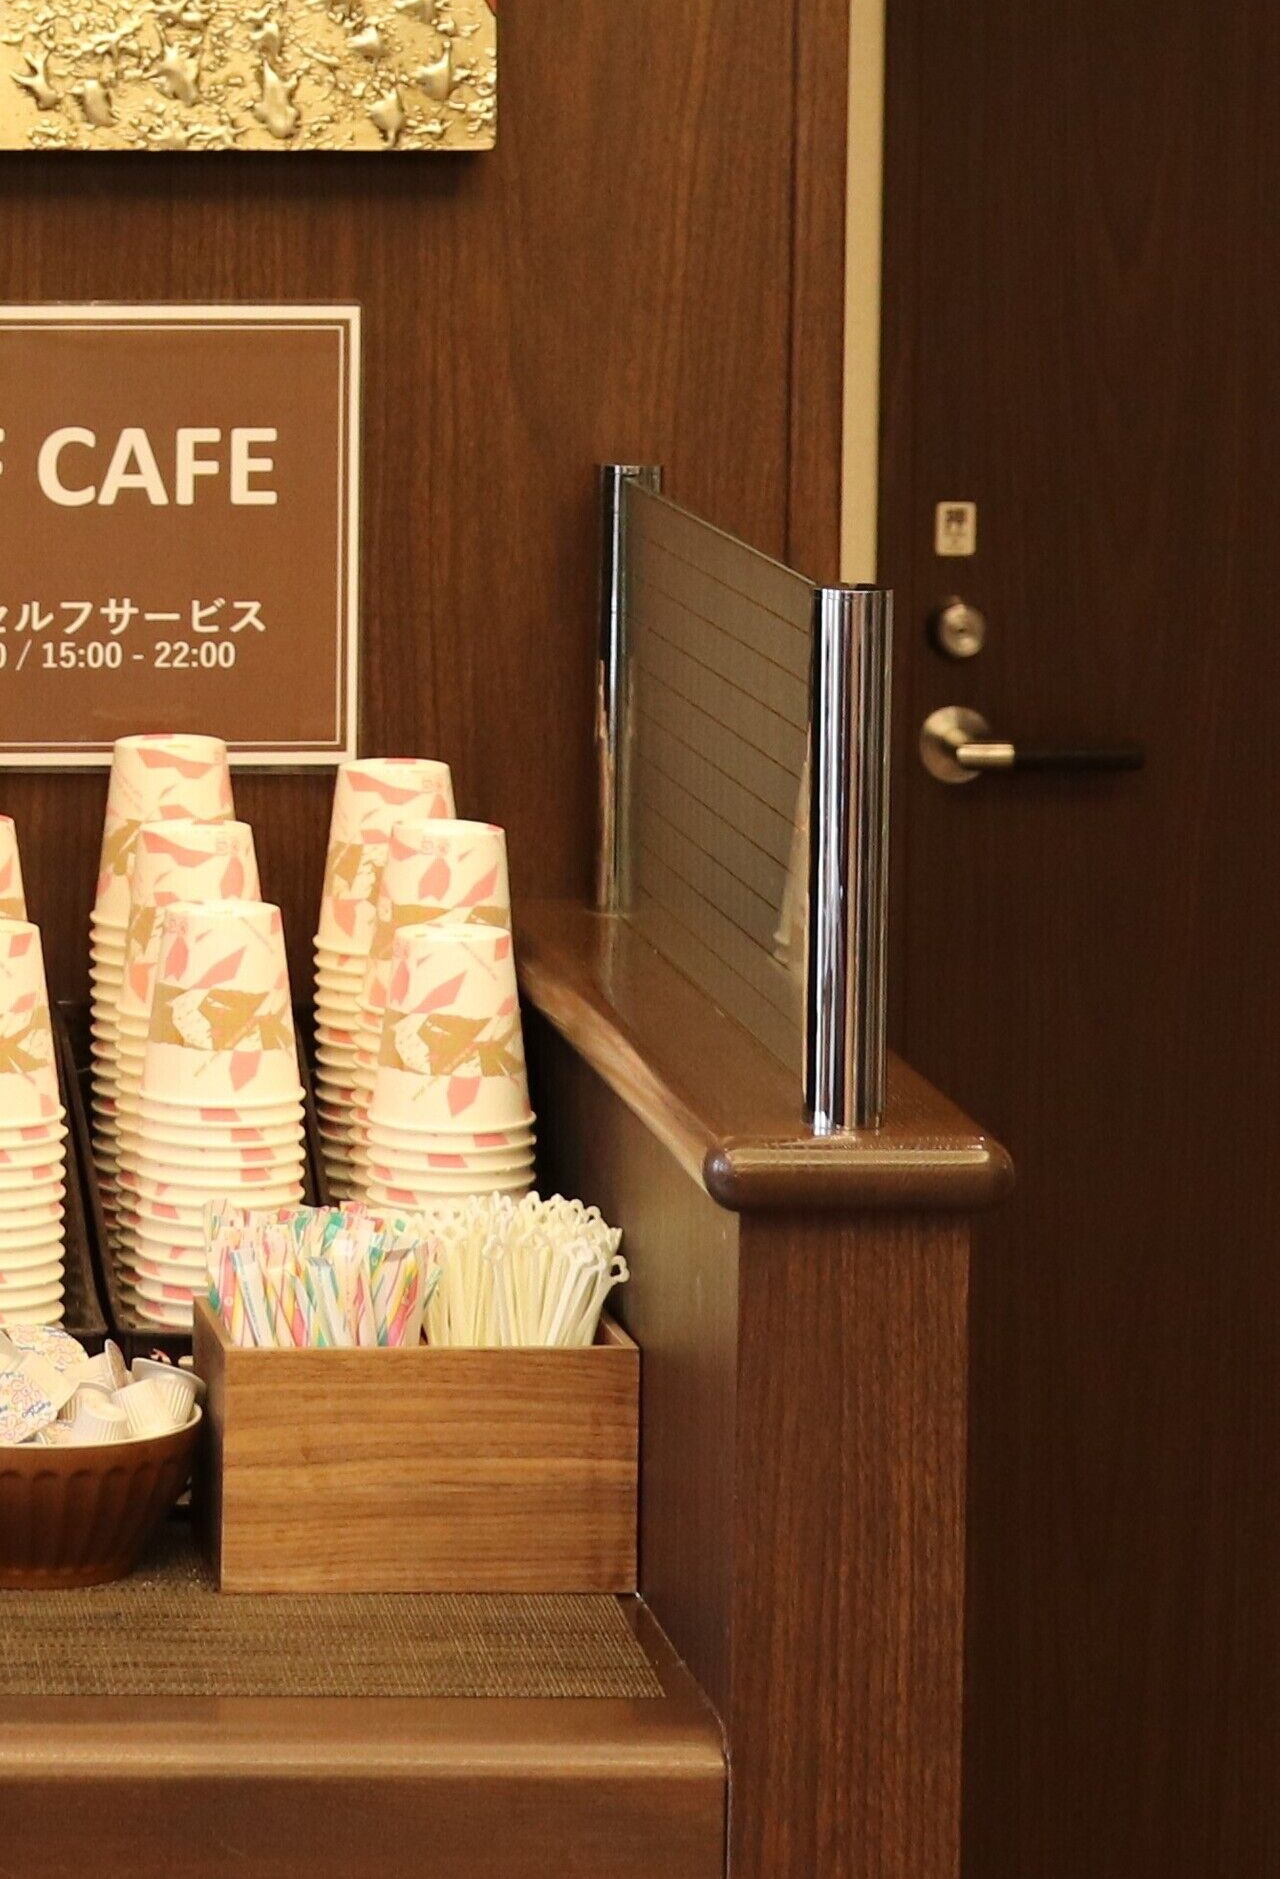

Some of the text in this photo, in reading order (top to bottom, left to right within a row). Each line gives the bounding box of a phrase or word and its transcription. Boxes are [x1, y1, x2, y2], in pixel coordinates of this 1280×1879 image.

[37, 426, 279, 508] CAFE
[41, 641, 123, 671] 15:00
[153, 641, 236, 671] 22:00
